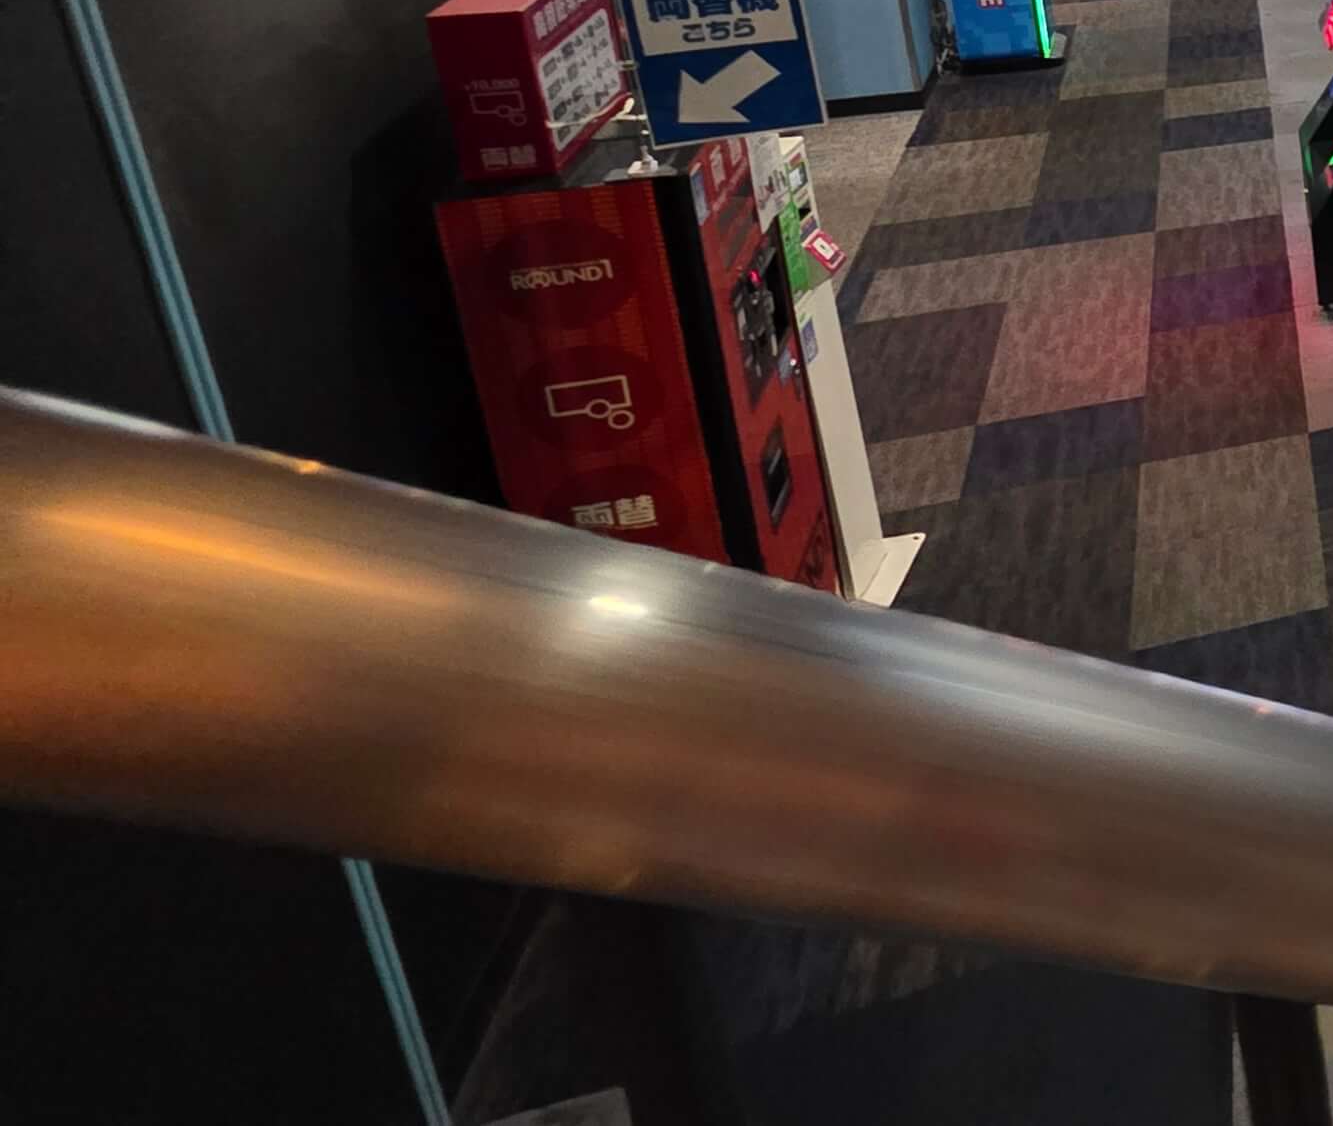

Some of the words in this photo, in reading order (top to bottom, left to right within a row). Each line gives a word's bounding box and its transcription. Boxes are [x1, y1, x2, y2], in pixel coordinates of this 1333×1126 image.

[682, 17, 757, 43] こちら
[510, 258, 614, 291] ROUND1
[570, 493, 659, 530] 両替
